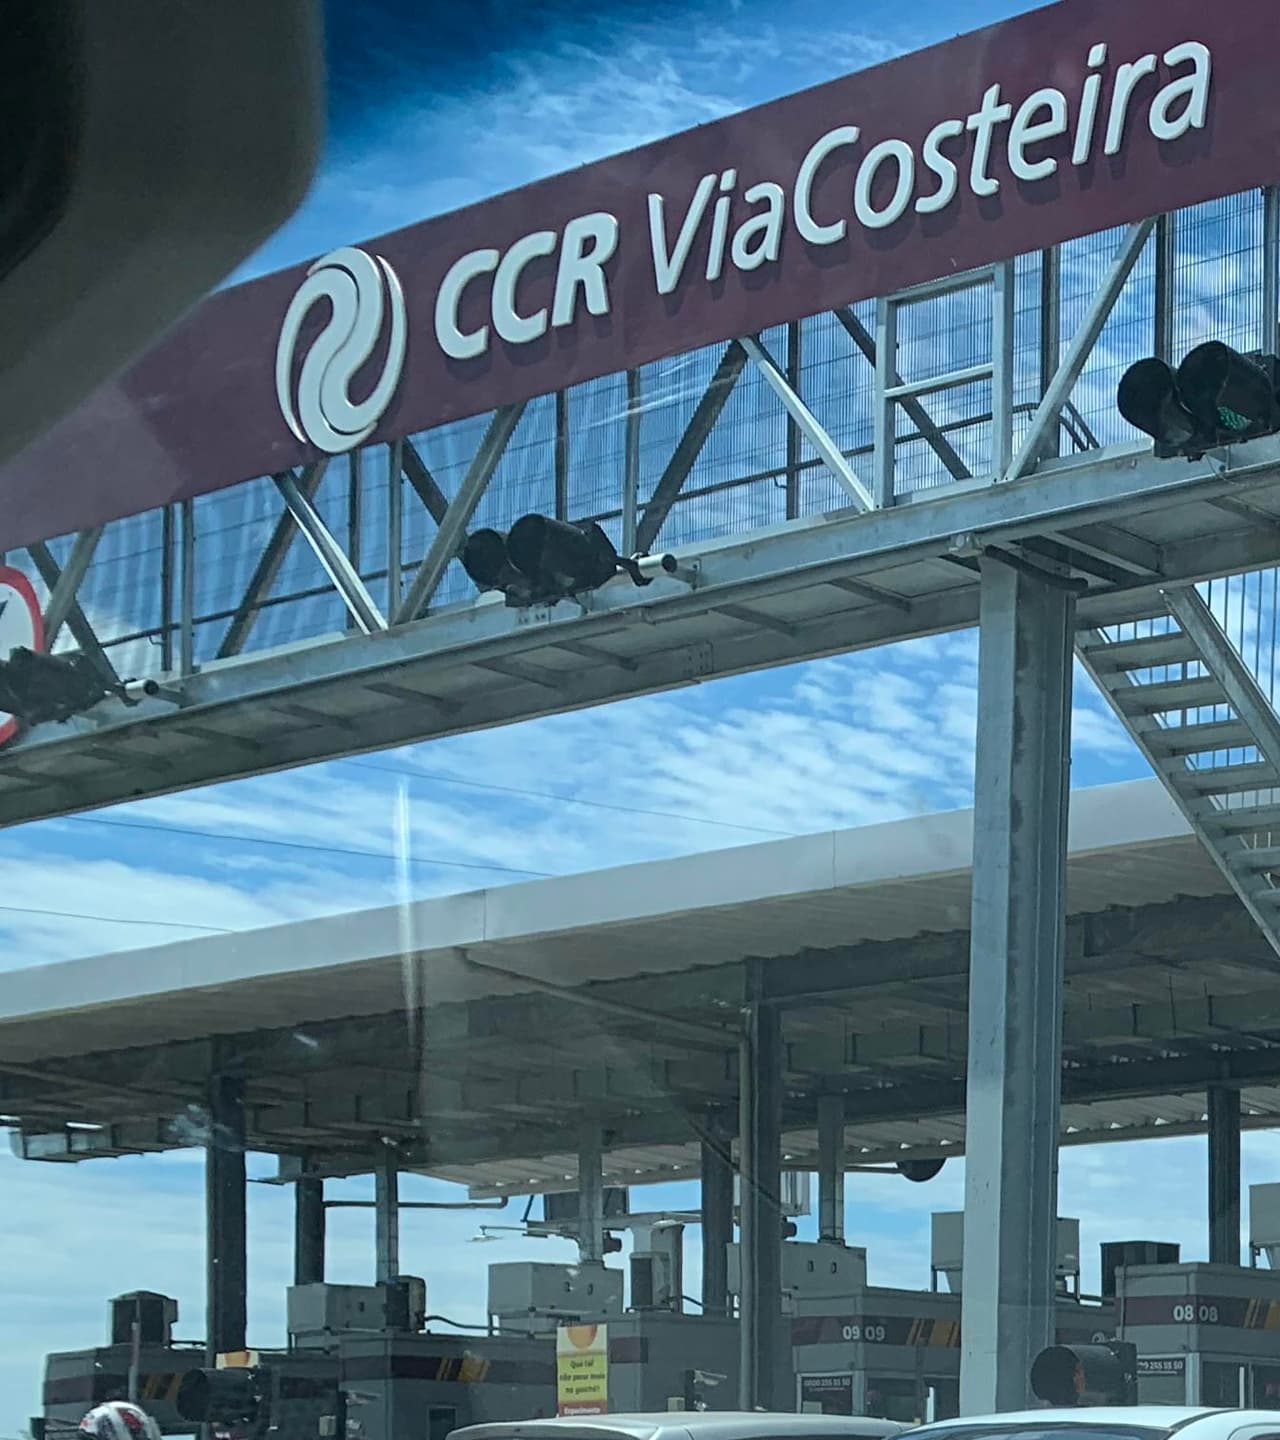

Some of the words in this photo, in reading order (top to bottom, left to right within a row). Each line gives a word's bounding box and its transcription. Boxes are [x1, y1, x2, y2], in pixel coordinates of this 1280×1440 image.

[434, 212, 618, 360] CCR
[647, 40, 1212, 297] ViaCosteira
[1173, 1305, 1194, 1321] 08
[1199, 1306, 1218, 1322] 08
[843, 1325, 861, 1340] 09
[865, 1326, 885, 1341] 09
